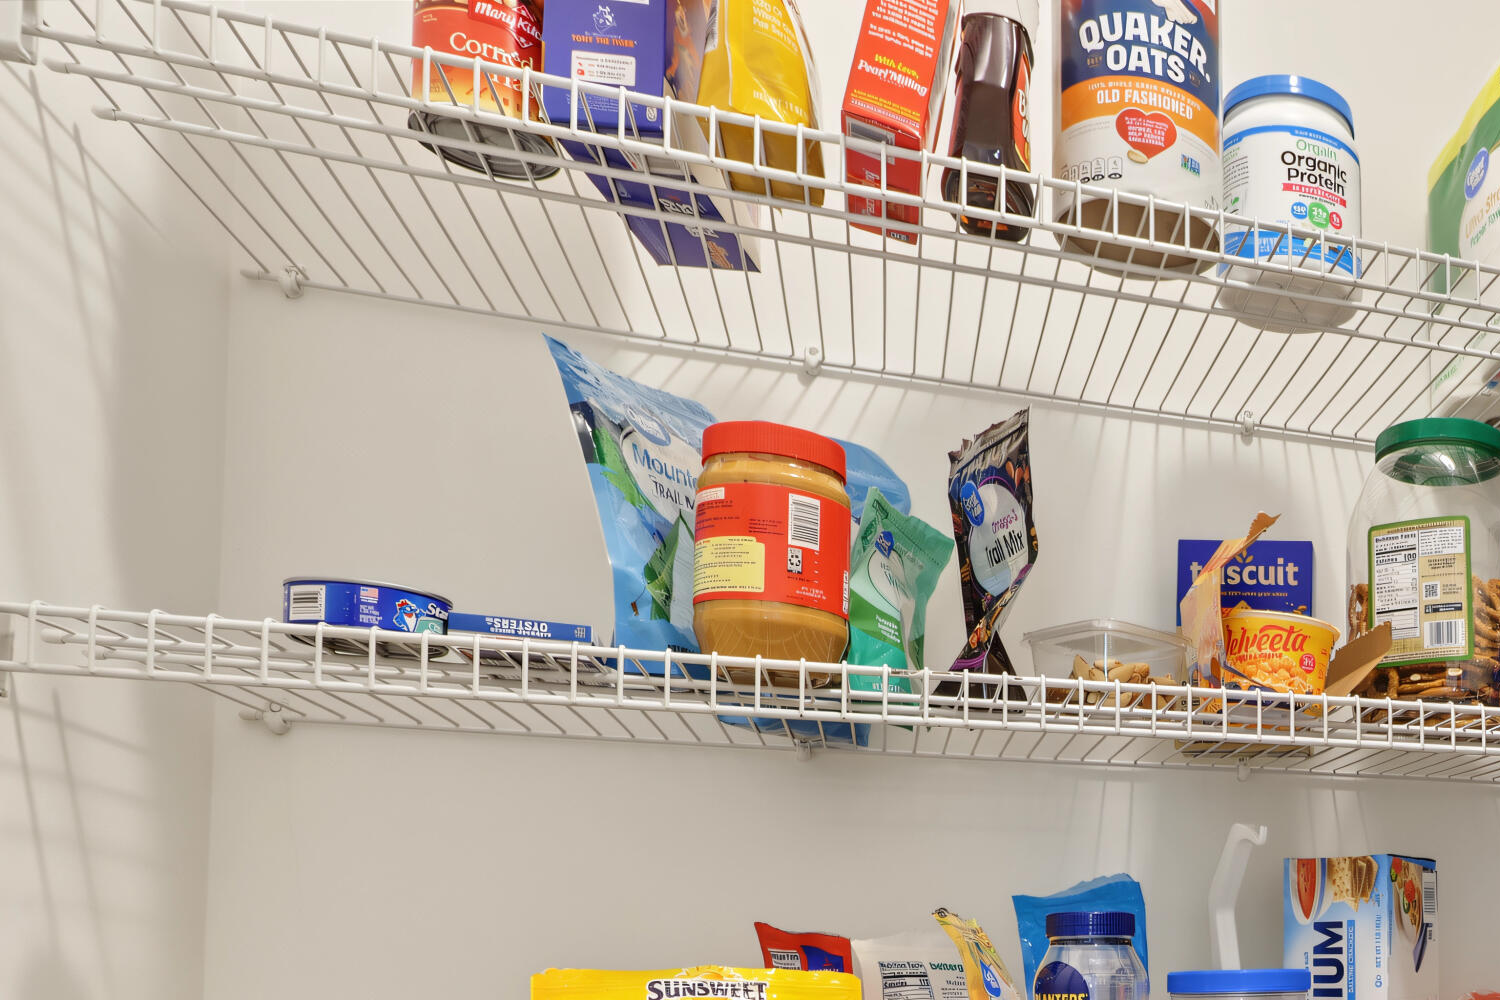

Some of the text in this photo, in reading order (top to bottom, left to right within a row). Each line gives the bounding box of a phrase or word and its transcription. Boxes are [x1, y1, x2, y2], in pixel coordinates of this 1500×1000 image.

[474, 1, 516, 28] Mary
[1106, 44, 1185, 83] OATS
[1097, 88, 1193, 120] OLD FASHIONED
[1281, 151, 1347, 183] Organic
[1287, 167, 1345, 196] Protein
[652, 480, 683, 505] TRAIL
[1006, 529, 1025, 557] Mix
[1190, 557, 1299, 586] tiscuit
[494, 618, 548, 633] OYSTERS
